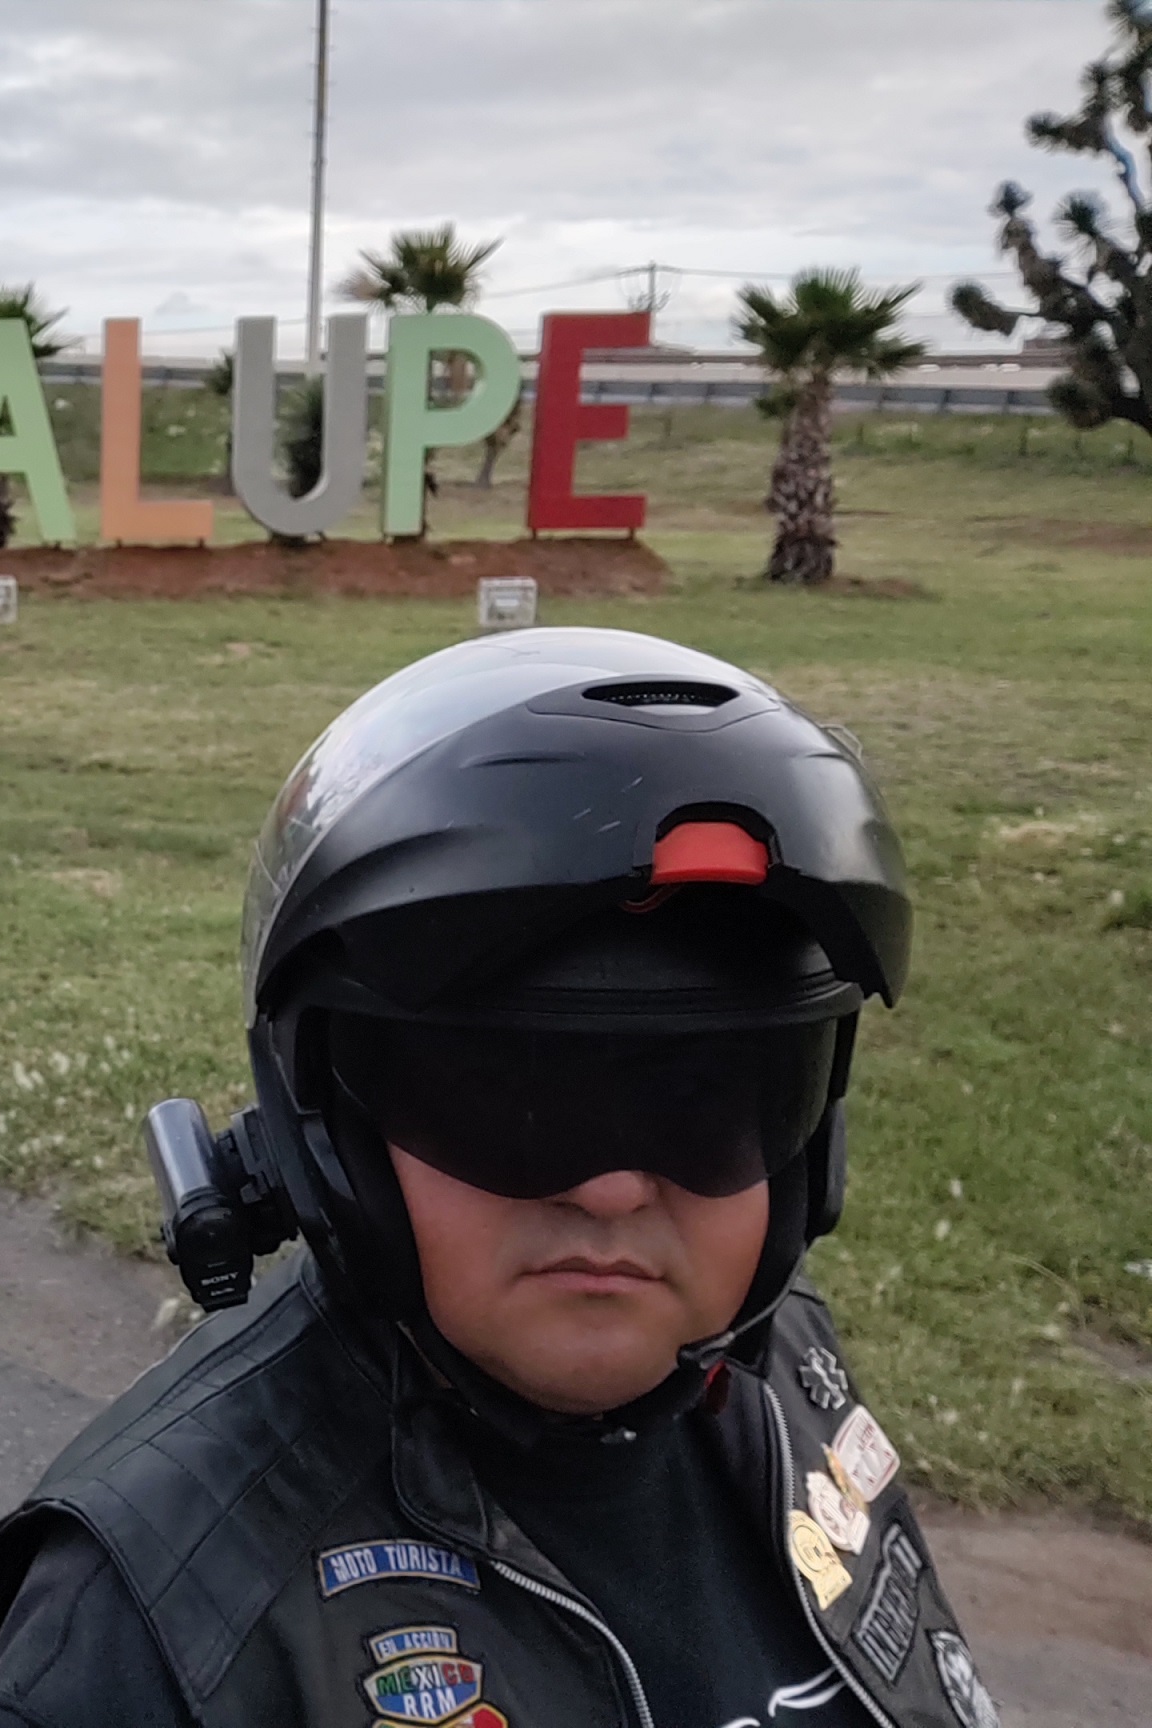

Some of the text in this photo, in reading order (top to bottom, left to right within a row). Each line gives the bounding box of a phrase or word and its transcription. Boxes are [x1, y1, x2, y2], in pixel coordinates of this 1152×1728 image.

[201, 1271, 239, 1286] SONY
[330, 1545, 463, 1583] MOTO TURISTA
[378, 1637, 398, 1657] EN
[375, 1662, 475, 1697] MEXICO
[402, 1687, 458, 1720] RRM
